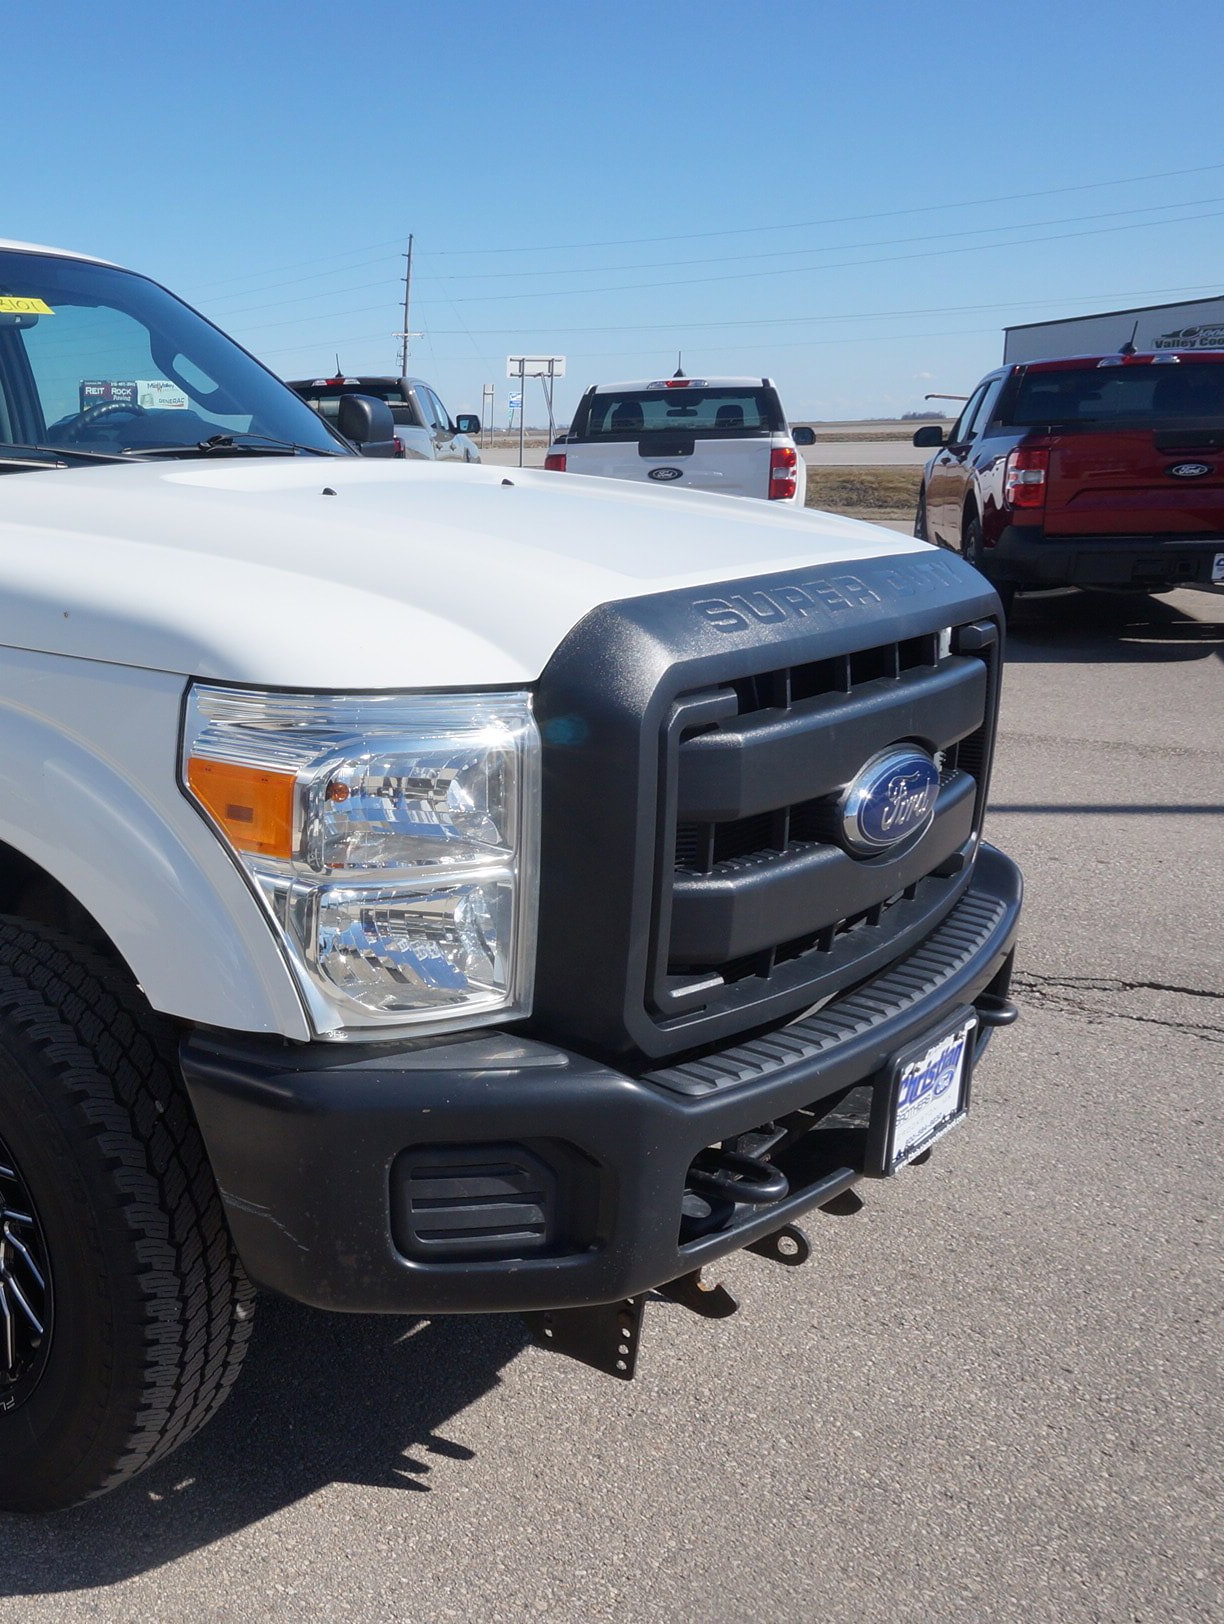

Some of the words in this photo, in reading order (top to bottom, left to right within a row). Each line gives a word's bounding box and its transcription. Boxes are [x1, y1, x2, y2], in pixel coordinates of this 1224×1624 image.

[1155, 339, 1196, 349] Valley
[85, 386, 105, 395] REIT
[111, 387, 132, 396] ROCK
[693, 575, 881, 634] SUPER
[881, 770, 929, 831] Ford
